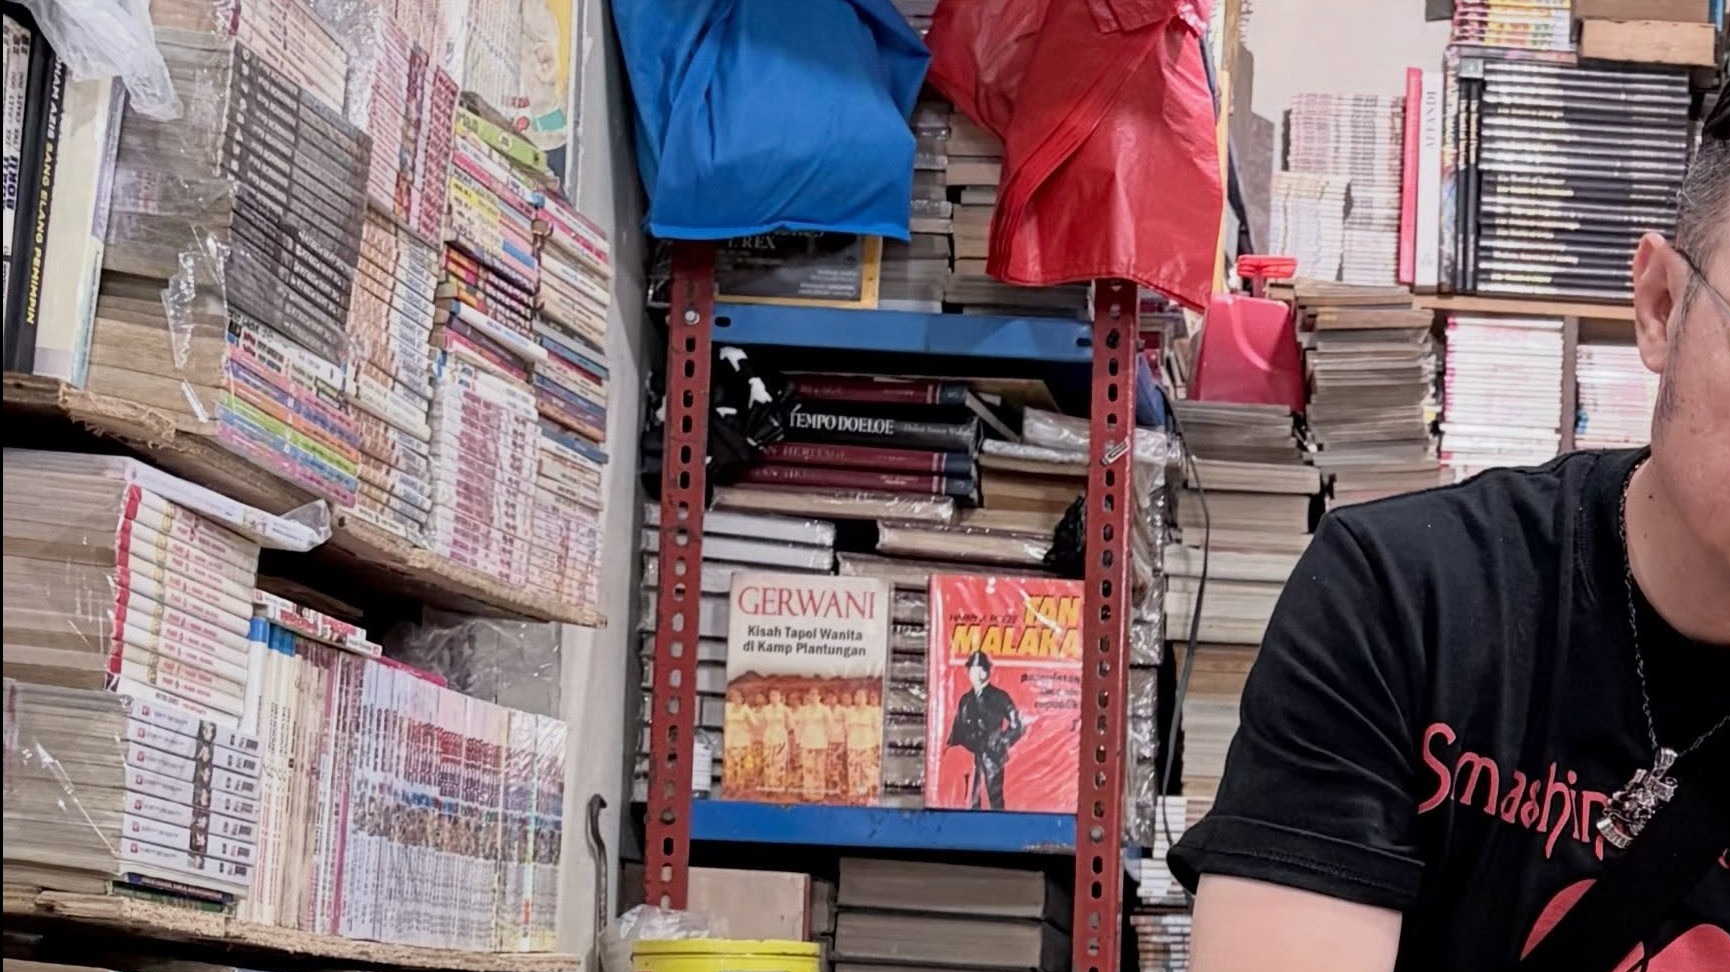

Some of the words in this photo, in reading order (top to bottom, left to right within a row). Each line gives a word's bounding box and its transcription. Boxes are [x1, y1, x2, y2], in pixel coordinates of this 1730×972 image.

[42, 142, 54, 186] SANG
[34, 190, 48, 243] ELANG
[26, 246, 43, 325] PEMIMPIN
[790, 404, 837, 430] TEMPO
[838, 414, 894, 435] DOELOE
[738, 586, 875, 619] GERWANI
[1025, 594, 1080, 626] TAN
[743, 640, 754, 652] di
[757, 641, 792, 656] Kamp
[796, 642, 866, 658] Plantungan
[747, 625, 781, 637] Kisah
[785, 626, 817, 640] Tapol
[820, 628, 863, 641] Wanita
[950, 623, 1079, 656] MALAKA
[1417, 722, 1612, 861] Smashin
